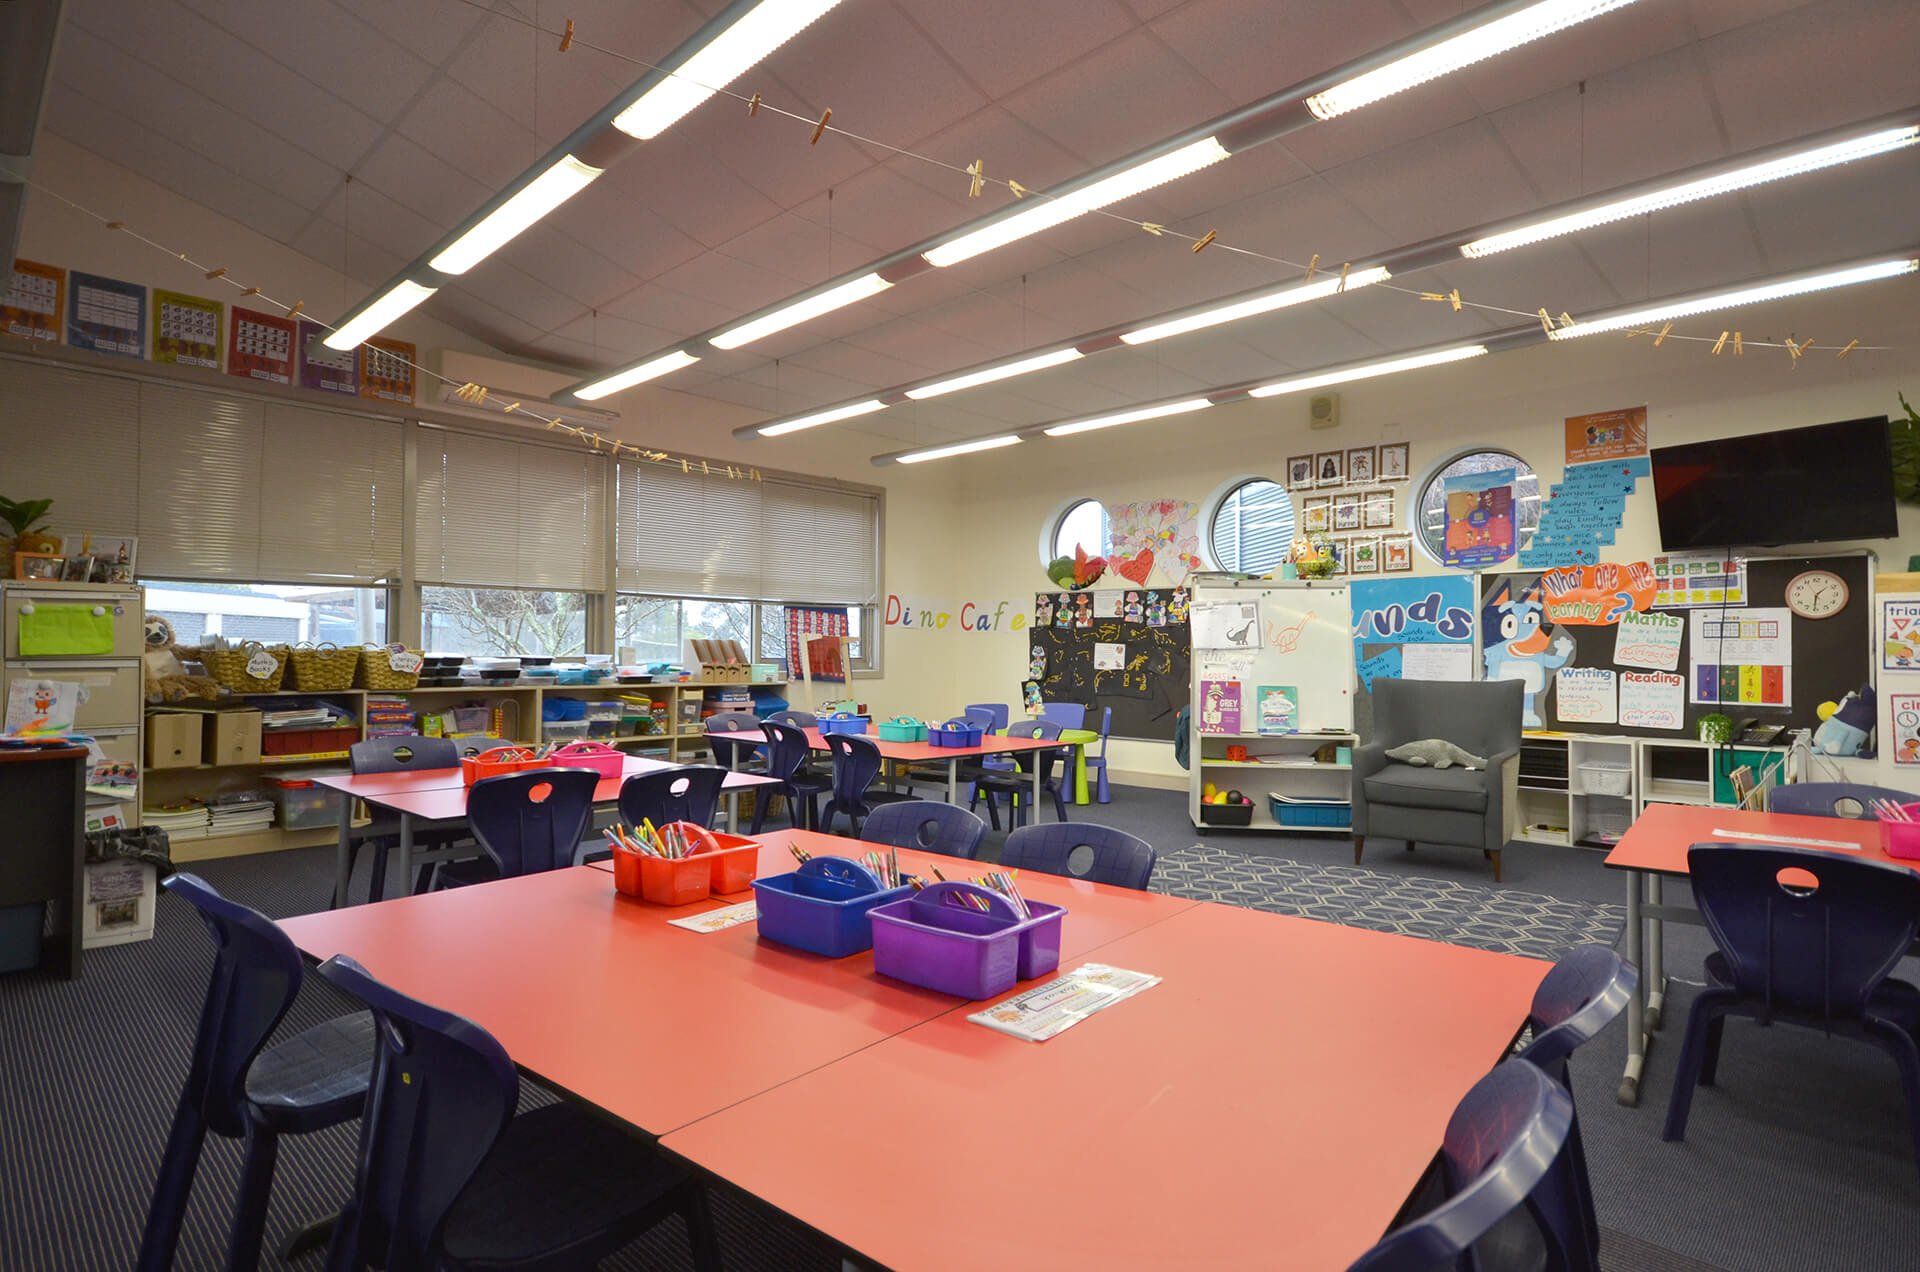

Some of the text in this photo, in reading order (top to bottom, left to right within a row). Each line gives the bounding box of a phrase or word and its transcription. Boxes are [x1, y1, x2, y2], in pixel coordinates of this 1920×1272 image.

[1543, 566, 1583, 598] What
[1594, 563, 1619, 591] are
[885, 594, 951, 630] Dino
[960, 601, 1027, 632] Cafe
[1623, 611, 1680, 628] Maths
[1561, 669, 1612, 681] Writing
[1625, 672, 1681, 687] Reading
[1219, 698, 1239, 708] GREY
